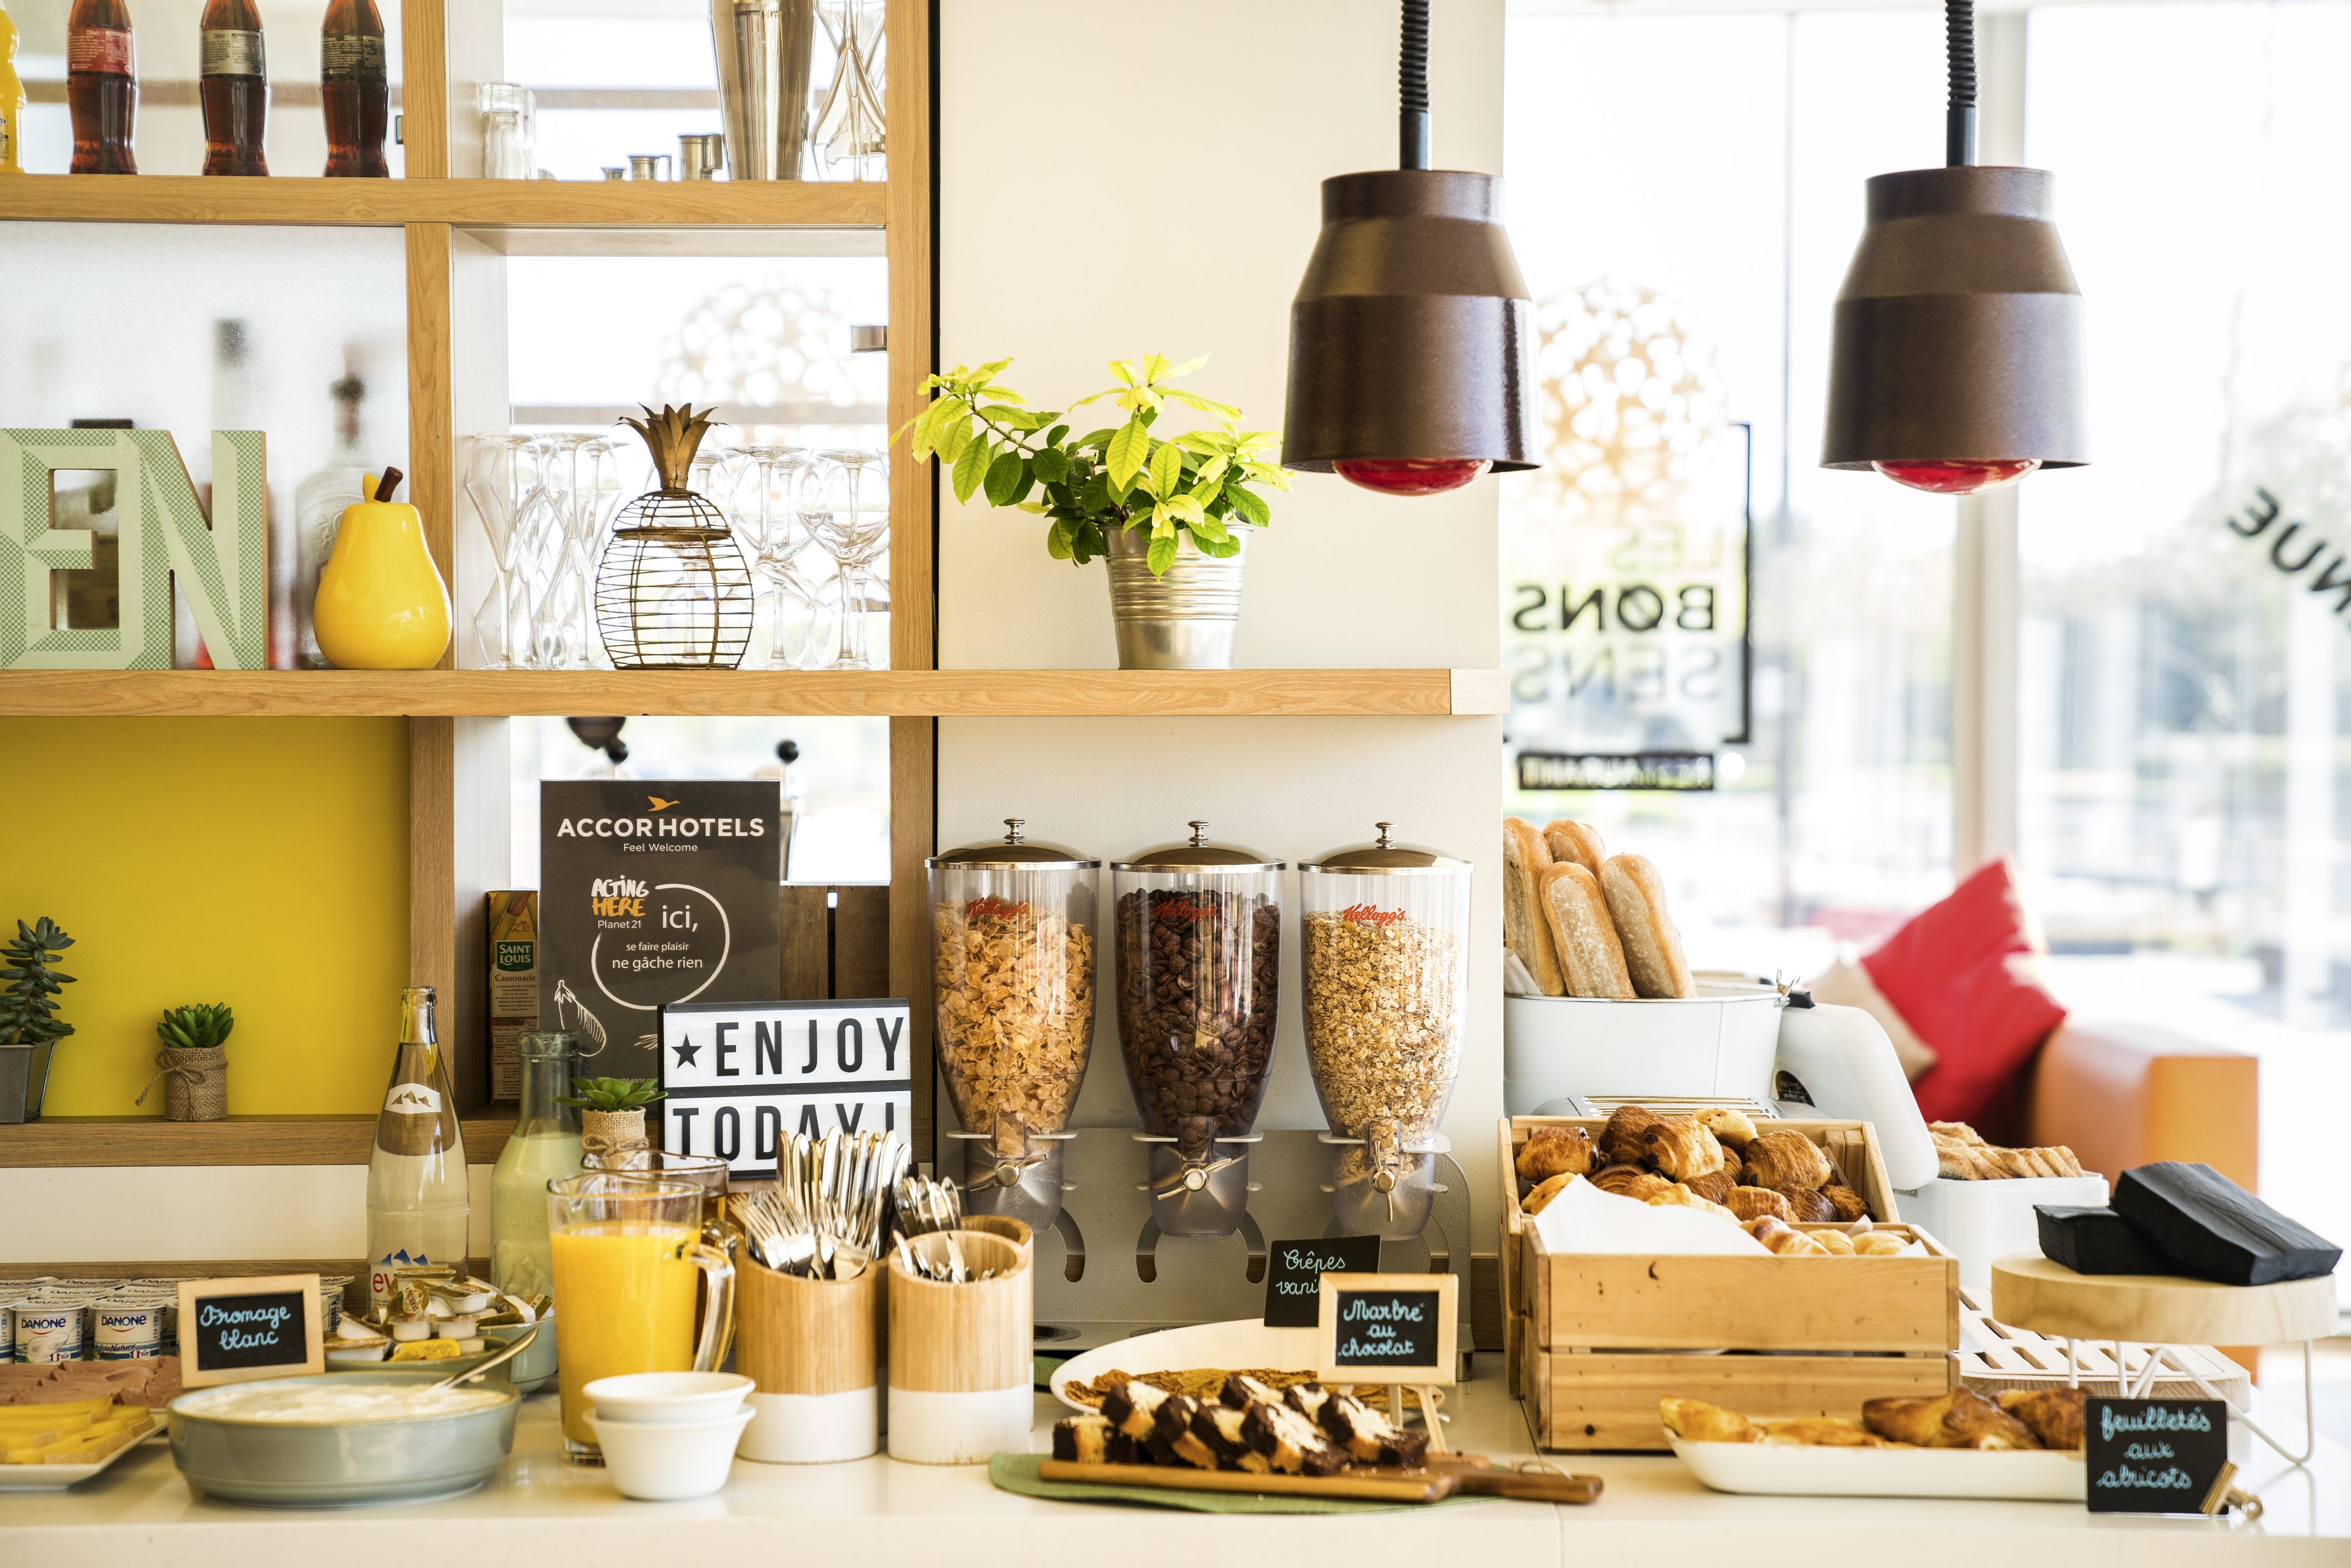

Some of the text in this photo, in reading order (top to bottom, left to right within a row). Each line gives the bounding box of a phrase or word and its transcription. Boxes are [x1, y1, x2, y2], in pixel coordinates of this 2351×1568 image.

[623, 843, 698, 852] Feel Welcome
[591, 897, 646, 917] HERE
[965, 897, 1027, 920] Kellogg's
[1155, 899, 1219, 923] Kellogg's
[1343, 903, 1406, 926] Kellogg's
[662, 905, 698, 932] ici,
[499, 944, 531, 954] SAINT
[639, 942, 659, 951] faire
[661, 942, 689, 953] plaisir
[499, 954, 531, 966] LOUIS
[612, 956, 703, 971] ne gâche rien
[715, 1017, 904, 1077] ENJOY
[1283, 1249, 1346, 1274] Crêpes
[1276, 1279, 1321, 1295] vani
[200, 1304, 292, 1329] Fromage
[219, 1328, 280, 1351] blanc
[1365, 1323, 1397, 1339] au
[111, 1343, 136, 1352] Nature
[1337, 1337, 1415, 1357] chocolat
[2099, 1405, 2212, 1442] feuilletés
[2123, 1440, 2175, 1460] aux
[2096, 1463, 2192, 1490] abricots
